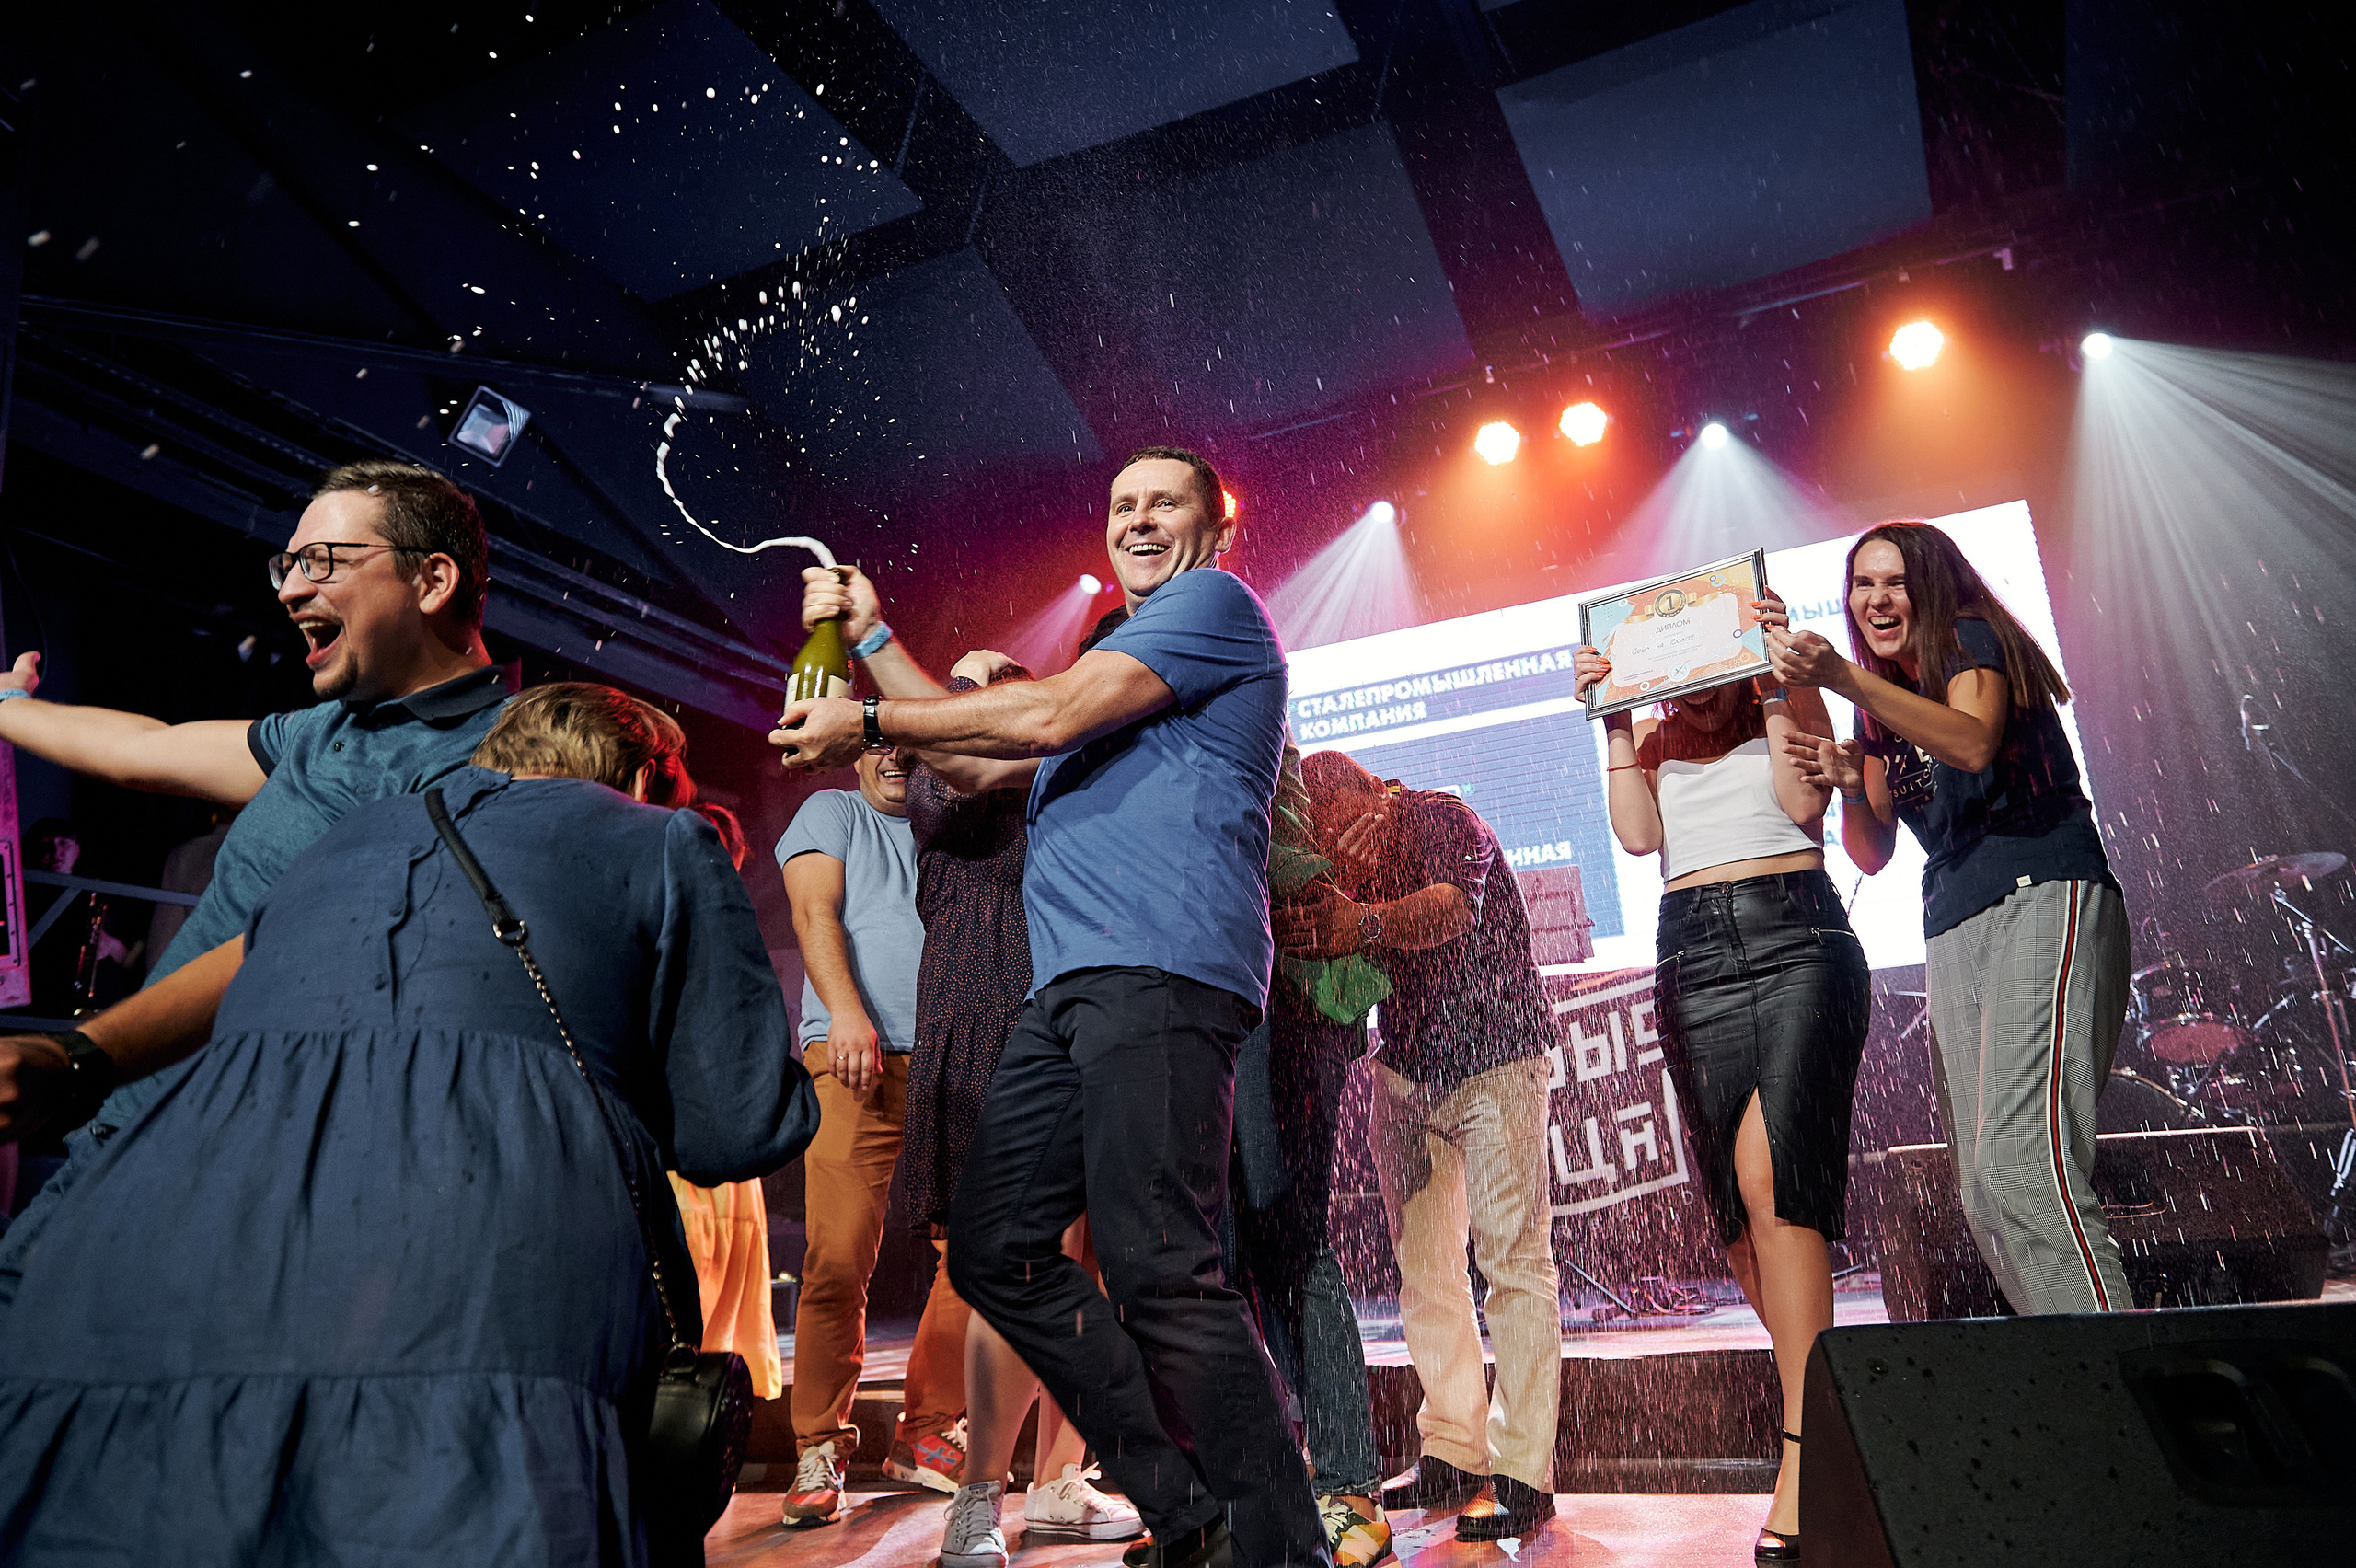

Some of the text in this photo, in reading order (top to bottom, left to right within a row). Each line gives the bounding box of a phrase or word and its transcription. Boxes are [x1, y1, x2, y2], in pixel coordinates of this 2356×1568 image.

[1666, 595, 1675, 611] 1
[1656, 617, 1691, 634] ДИПЛОМ
[1298, 650, 1573, 718] СТАЛЕПРОМЫШЛЕННАЯ
[1300, 701, 1427, 740] КОМПАНИЯ
[1505, 841, 1572, 867] ННАЯ
